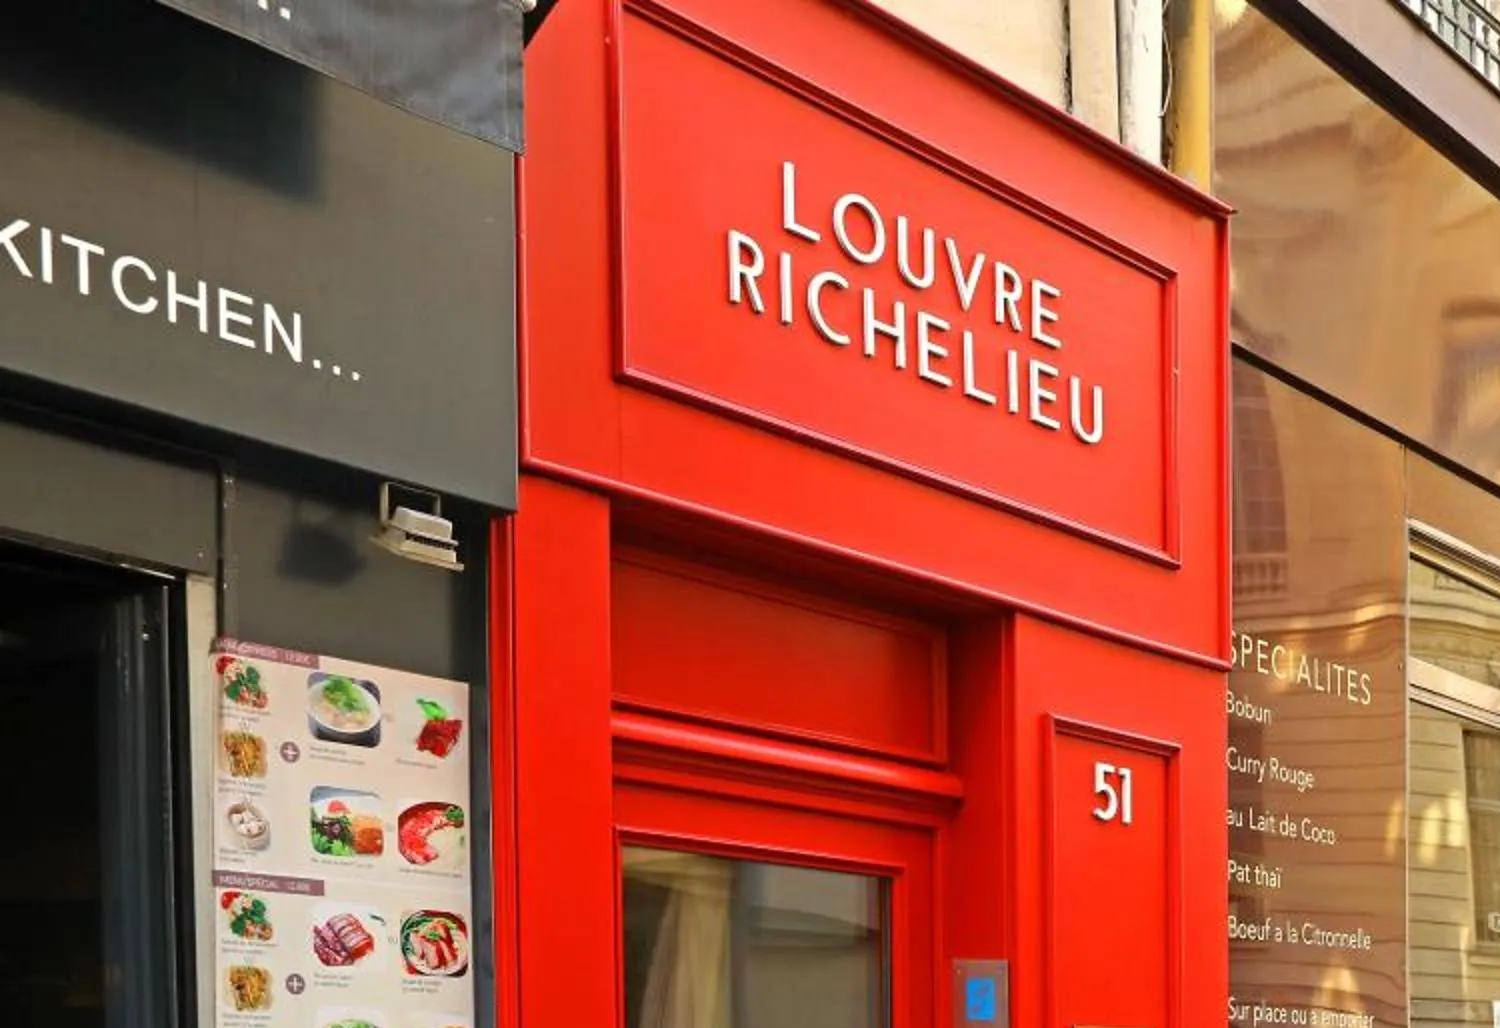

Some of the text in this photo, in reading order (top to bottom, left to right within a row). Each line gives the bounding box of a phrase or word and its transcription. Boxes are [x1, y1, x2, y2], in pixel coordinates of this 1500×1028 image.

[783, 160, 1062, 349] LOUVRE
[727, 229, 1104, 446] RICHELIEU
[1226, 689, 1273, 727] Bobun
[1225, 746, 1316, 793] Curry Rouge
[1092, 761, 1133, 825] 51
[1226, 807, 1337, 846] au Lait de Coco
[1227, 859, 1251, 884] Pat
[1227, 915, 1272, 942] Boeuf
[1286, 920, 1299, 944] la
[1302, 922, 1372, 951] Citronnelle
[1227, 996, 1251, 1021] Sur
[1253, 1000, 1288, 1028] place
[1291, 1009, 1308, 1026] ou
